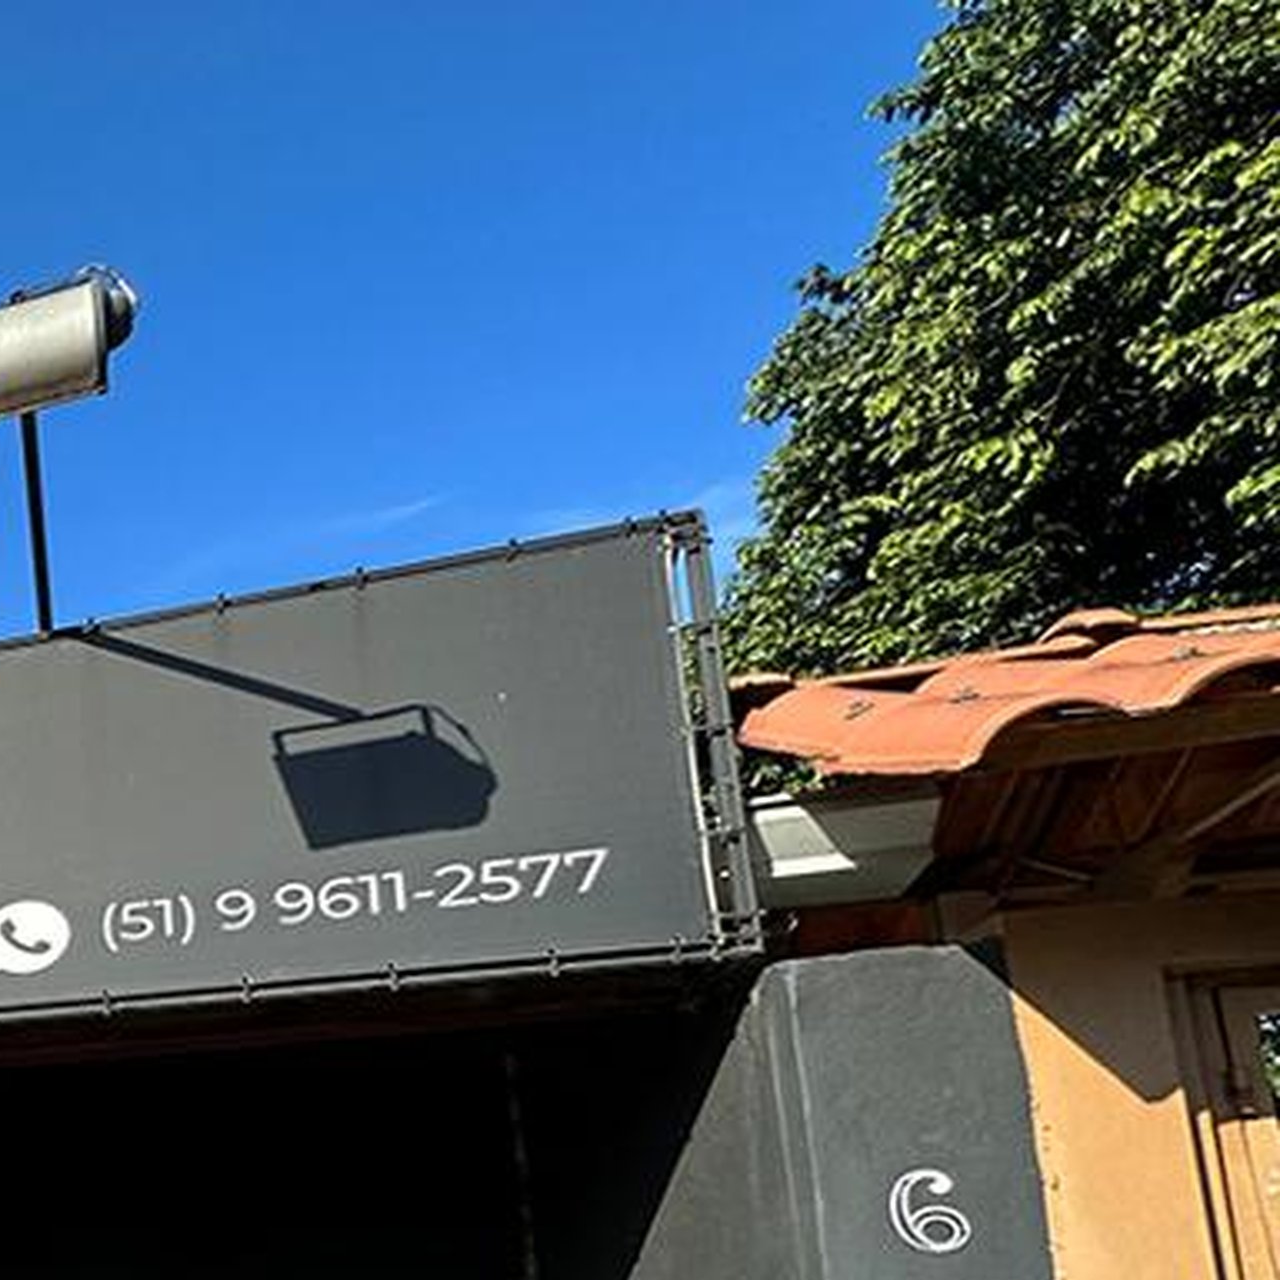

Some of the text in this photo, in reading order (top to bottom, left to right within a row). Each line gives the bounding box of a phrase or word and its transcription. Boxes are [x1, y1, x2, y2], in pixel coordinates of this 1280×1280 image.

[100, 847, 611, 954] (51) 9 9611-2577
